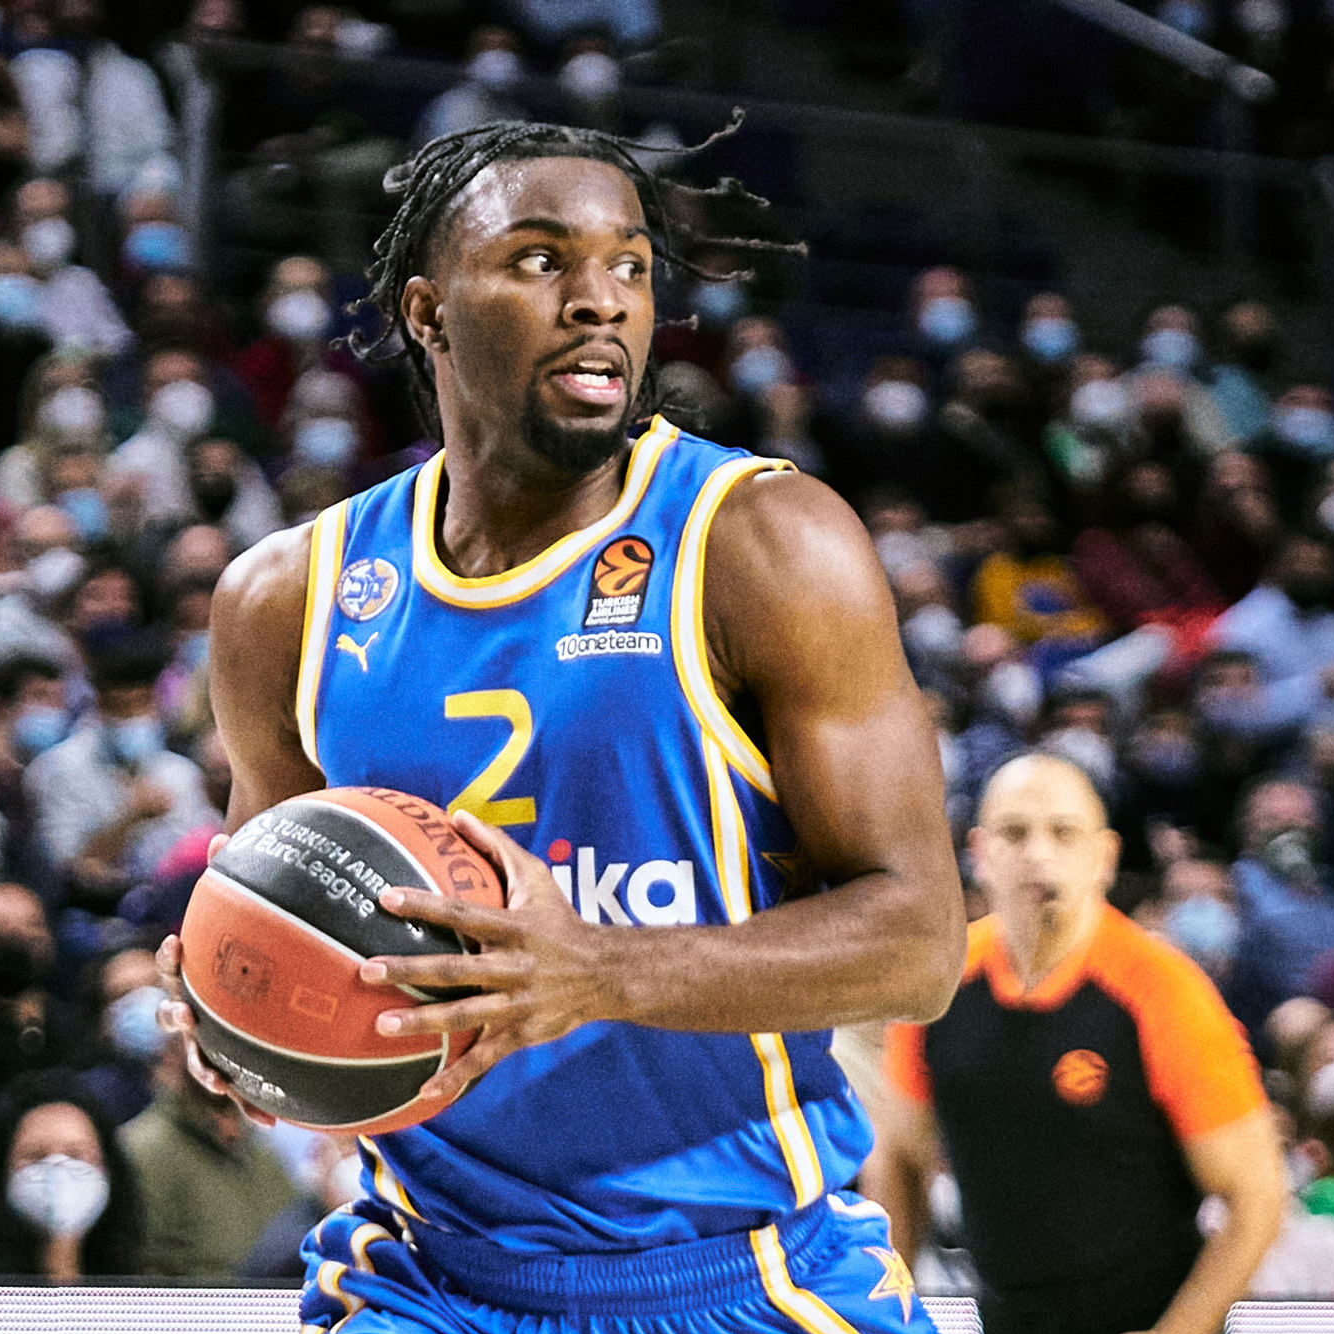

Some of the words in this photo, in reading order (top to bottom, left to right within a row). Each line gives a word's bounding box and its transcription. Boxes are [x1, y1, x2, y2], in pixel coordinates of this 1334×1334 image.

[443, 688, 538, 827] 2
[253, 832, 376, 919] EuroLeague
[272, 817, 351, 866] TURKISH
